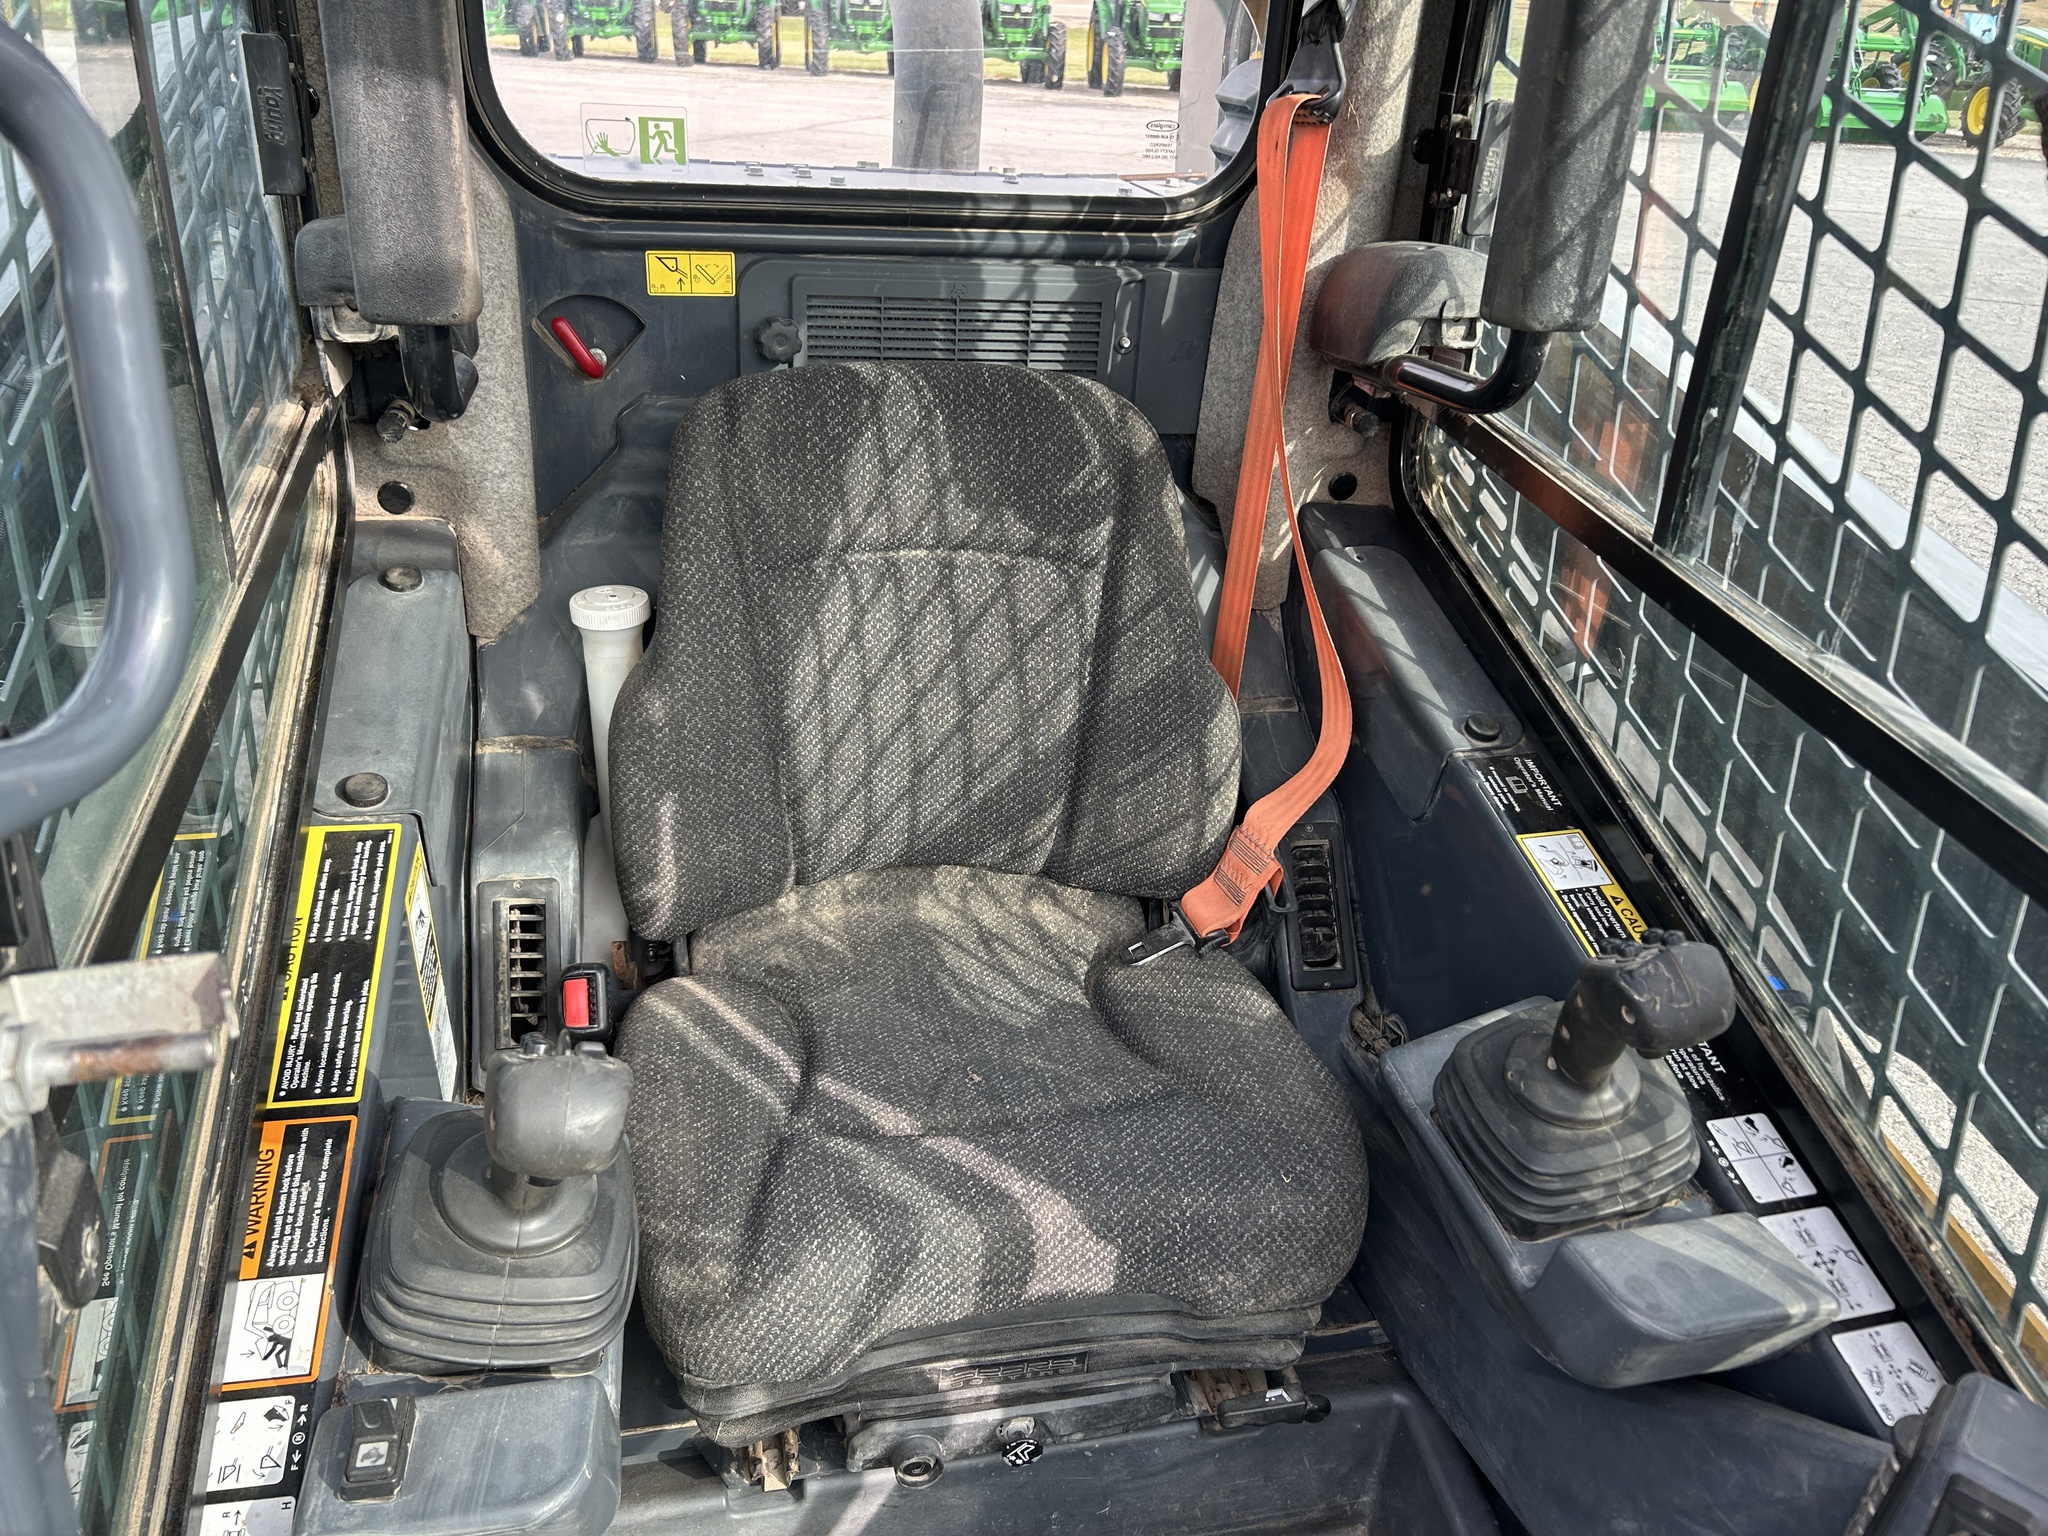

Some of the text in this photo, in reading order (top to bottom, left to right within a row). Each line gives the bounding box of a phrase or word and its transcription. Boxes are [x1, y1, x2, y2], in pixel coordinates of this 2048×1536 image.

[1524, 759, 1562, 806] IMPORTANT
[1534, 788, 1554, 811] Manual
[355, 841, 364, 853] stop
[362, 839, 373, 859] leaving.
[324, 858, 333, 872] away.
[352, 853, 362, 869] brake,
[359, 859, 368, 875] before
[376, 853, 384, 867] pedal
[320, 873, 328, 889] others
[358, 876, 367, 886] key
[372, 867, 383, 893] especially
[347, 882, 357, 901] engage
[356, 886, 364, 905] remove
[369, 893, 379, 909] clean,
[313, 901, 323, 922] children
[325, 888, 340, 936] Never carry riders.
[343, 901, 354, 918] boom,
[1589, 887, 1627, 938] Avoid Overturn
[310, 923, 320, 937] Keep
[340, 919, 349, 935] Lower
[350, 917, 359, 935] engine
[365, 920, 375, 934] Keep
[1620, 908, 1642, 938] CAU
[332, 972, 342, 997] controls.
[361, 978, 373, 996] place.
[325, 1005, 336, 1030] function
[356, 1004, 366, 1030] windows
[281, 978, 309, 1089] AVOID INJURY Read and understand
[290, 973, 319, 1089] Operator's Manual before operating this
[324, 1030, 332, 1042] and
[354, 1030, 362, 1042] and
[331, 999, 353, 1086] Keep safety devices working.
[319, 1043, 329, 1068] location
[351, 1043, 360, 1067] screens
[1698, 1041, 1726, 1073] TANT
[300, 1060, 311, 1088] machine.
[347, 1068, 357, 1085] Keep
[1665, 1054, 1684, 1079] before
[1670, 1049, 1700, 1089] run at slow
[1691, 1053, 1726, 1101] of hydraulics
[315, 1069, 325, 1087] Know
[283, 1154, 295, 1177] before
[246, 1148, 275, 1236] WARNING
[280, 1178, 291, 1193] lock
[276, 1194, 287, 1215] boom
[278, 1128, 309, 1267] working on or around this machine with
[304, 1138, 333, 1264] See Operator's Manual for complete
[294, 1205, 306, 1227] boom
[290, 1228, 302, 1252] loader
[266, 1239, 280, 1267] Always
[288, 1253, 297, 1265] the
[300, 1404, 309, 1412] R
[222, 1511, 231, 1519] R
[281, 1501, 292, 1510] H
